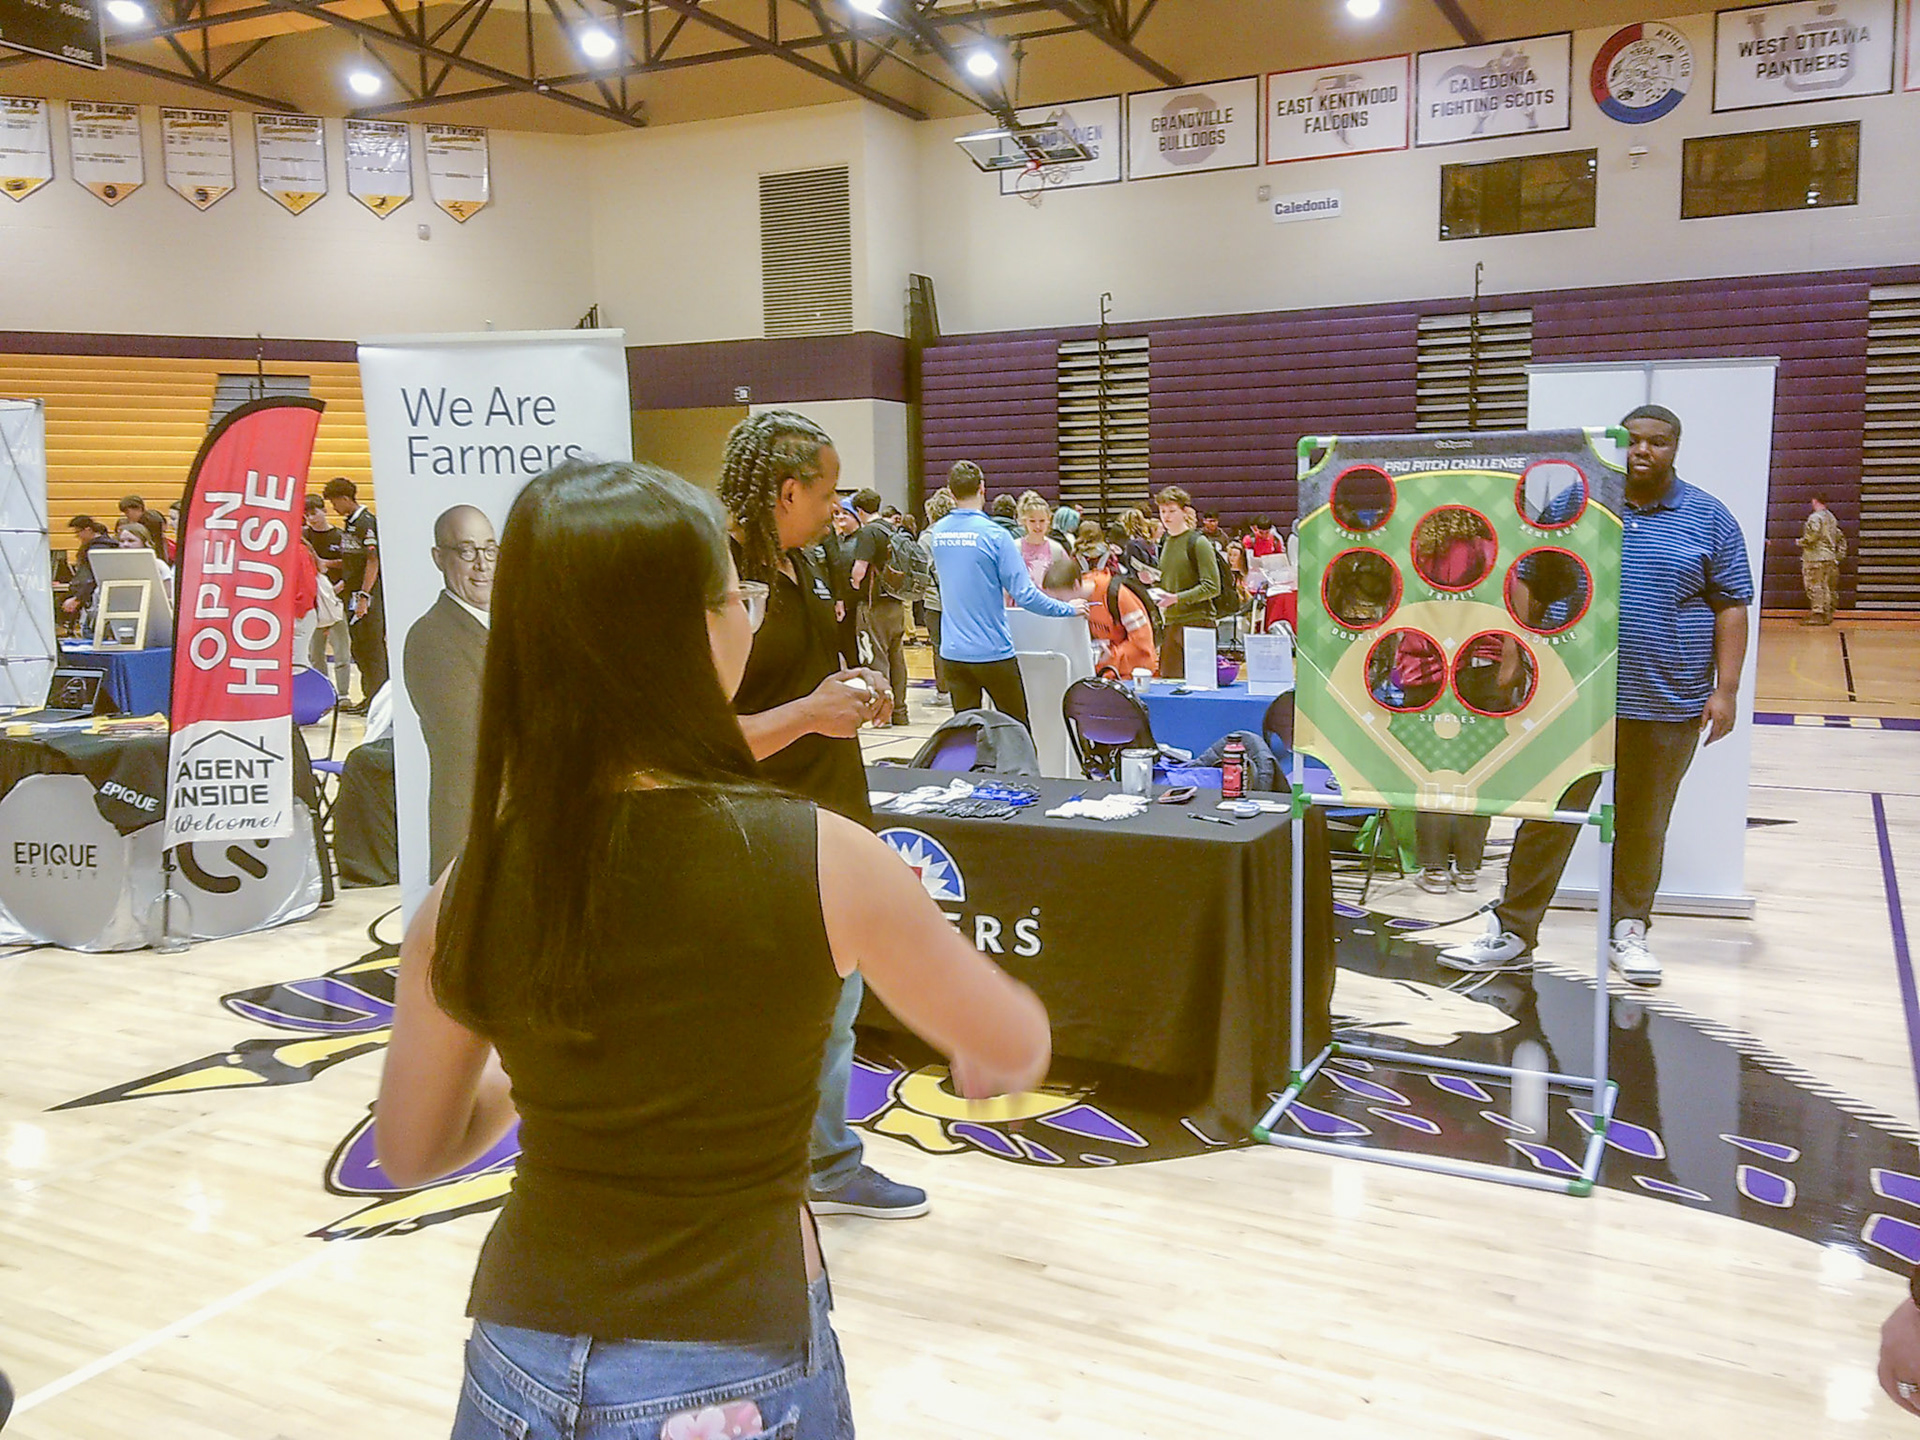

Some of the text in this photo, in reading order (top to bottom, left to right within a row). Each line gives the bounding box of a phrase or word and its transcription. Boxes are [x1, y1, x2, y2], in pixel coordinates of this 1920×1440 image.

[1738, 26, 1870, 57] WEST OTTAWA
[1756, 52, 1850, 79] PANTHERS
[1450, 69, 1537, 94] CALEDONIA
[1277, 86, 1398, 116] EAST KENTWOOD
[1431, 89, 1554, 118] FIGHTING SCOTS
[1151, 107, 1234, 133] GRANDVILLE
[1304, 111, 1369, 134] FALCONS
[1159, 129, 1226, 152] BULLDOGS
[1275, 197, 1339, 215] Caledonia
[401, 386, 556, 427] We Are
[1384, 457, 1527, 472] PRO PITCH CHALLENGE
[190, 491, 243, 671] OPEN
[226, 470, 297, 696] HOUSE
[1428, 588, 1476, 601] TRIPLE
[1523, 630, 1578, 646] DOUBLE
[1419, 714, 1476, 724] SINGLES
[175, 758, 274, 783] AGENT
[100, 780, 160, 812] EPIQUE
[175, 784, 269, 808] INSIDE
[171, 811, 282, 835] Welcome!
[13, 841, 98, 867] EPIQUE
[14, 868, 98, 880] REALTY
